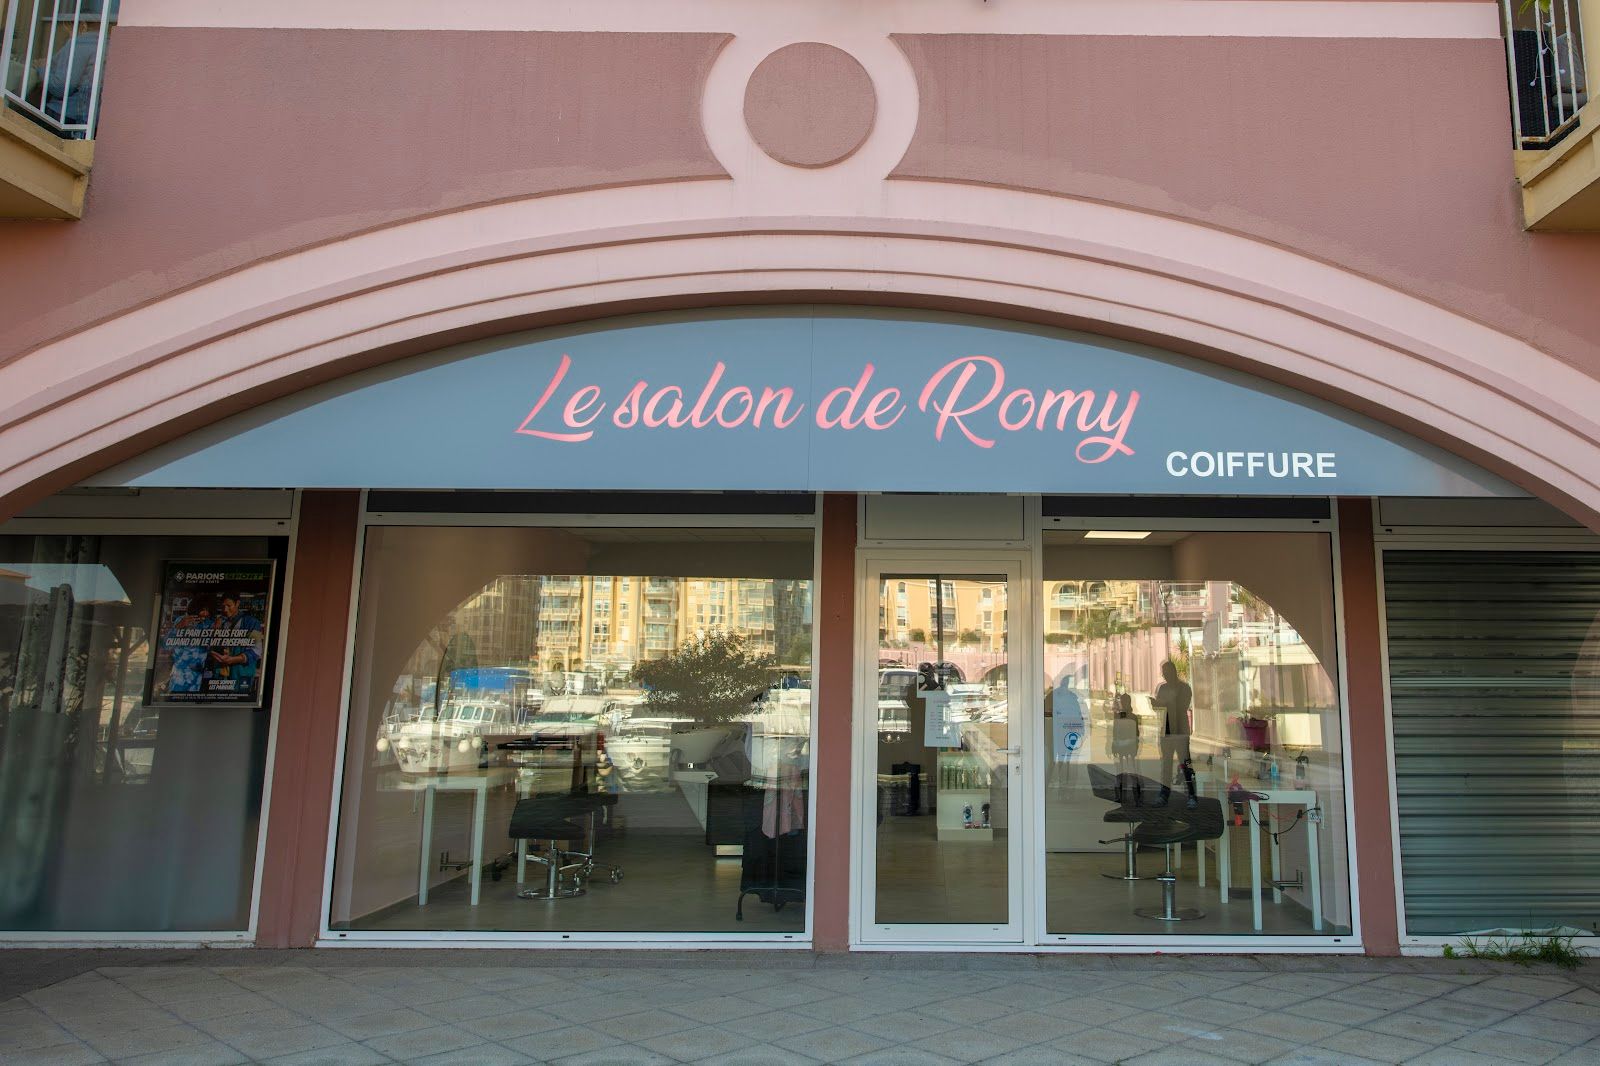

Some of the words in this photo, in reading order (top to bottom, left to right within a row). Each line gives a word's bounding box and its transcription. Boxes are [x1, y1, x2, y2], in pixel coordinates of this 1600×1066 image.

[516, 354, 606, 442] Le
[613, 361, 804, 429] salon
[815, 362, 907, 431] de
[918, 355, 1140, 464] Romy
[1166, 451, 1336, 478] COIFFURE
[185, 572, 225, 580] PARIONS
[176, 629, 185, 637] LE
[185, 629, 201, 637] PARI
[201, 629, 214, 637] EST
[214, 629, 231, 637] PLUS
[230, 629, 249, 637] FORT
[166, 638, 190, 646] QUAND
[190, 638, 201, 646] ON
[201, 638, 210, 646] LE
[210, 638, 221, 646] VIT
